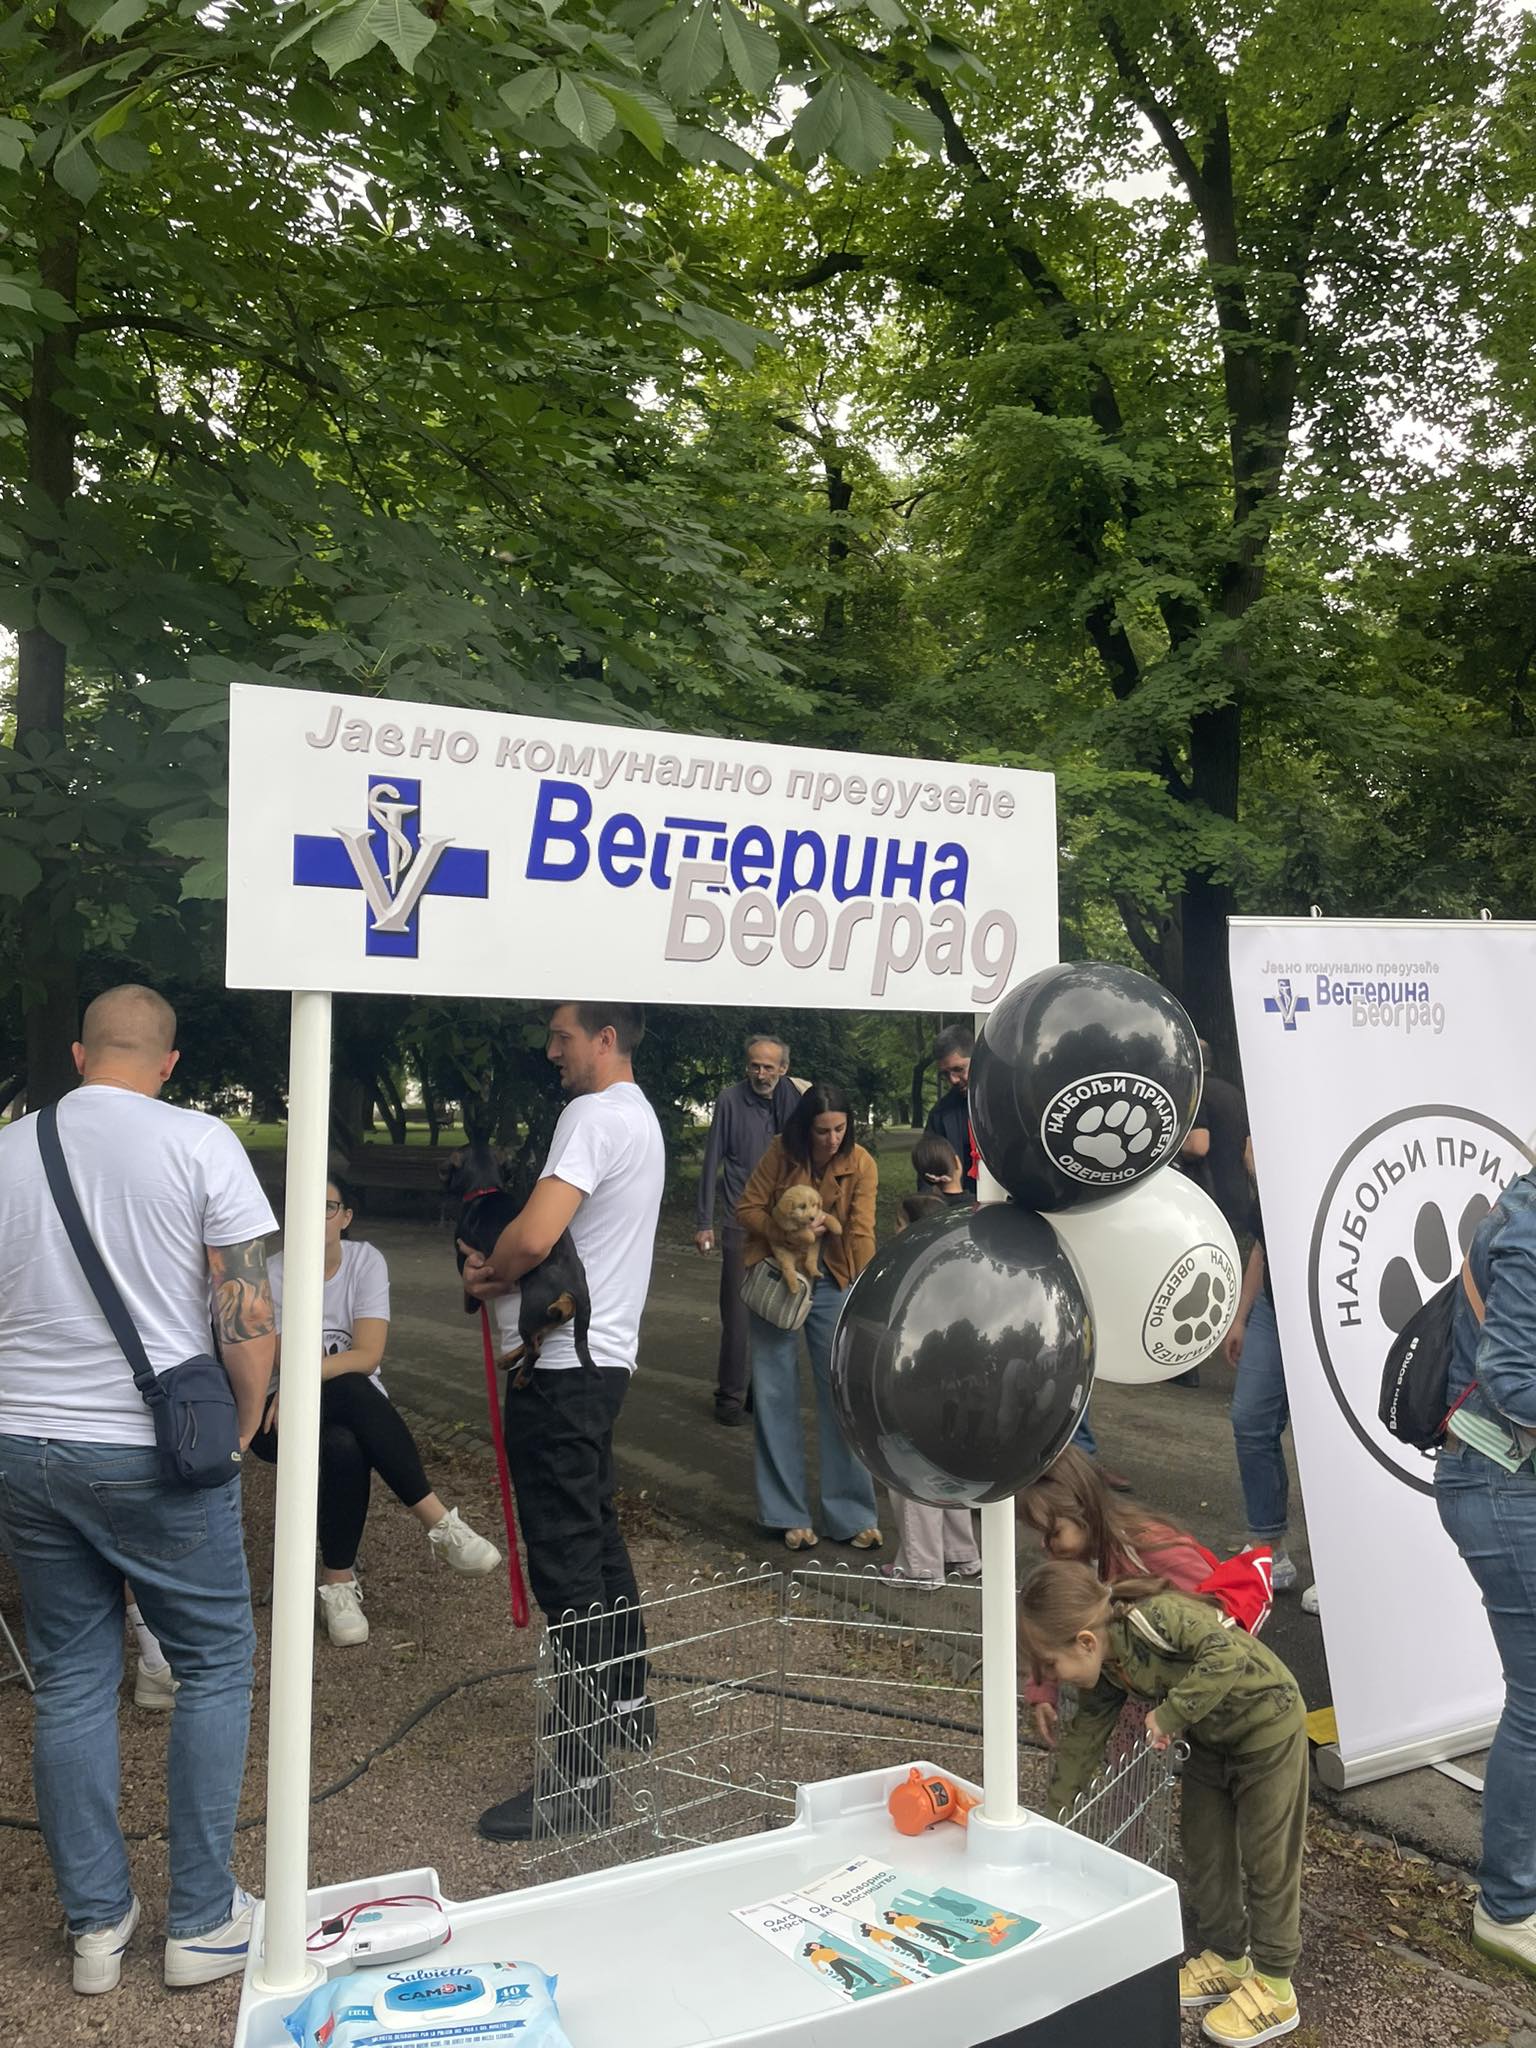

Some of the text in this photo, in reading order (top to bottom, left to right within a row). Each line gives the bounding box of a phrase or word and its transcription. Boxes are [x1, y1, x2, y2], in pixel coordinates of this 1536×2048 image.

[305, 704, 1016, 819] Јавно комунално предузеће
[525, 778, 970, 911] Ветерина
[664, 860, 1018, 1004] Београд
[1261, 960, 1441, 977] Јавно комунално предузеће
[1316, 974, 1430, 1007] Ветерина
[1352, 995, 1446, 1035] Београд
[1047, 1078, 1173, 1158] НАЈБОЉИ ПРИЈАТЕЉ
[1058, 1154, 1137, 1182] ОВЕРЕНО
[1335, 1139, 1427, 1329] НАЈБОЉИ
[1149, 1257, 1196, 1328] ОВЕРЕНО
[1396, 1350, 1414, 1386] BORG
[397, 1982, 473, 2002] CAMON
